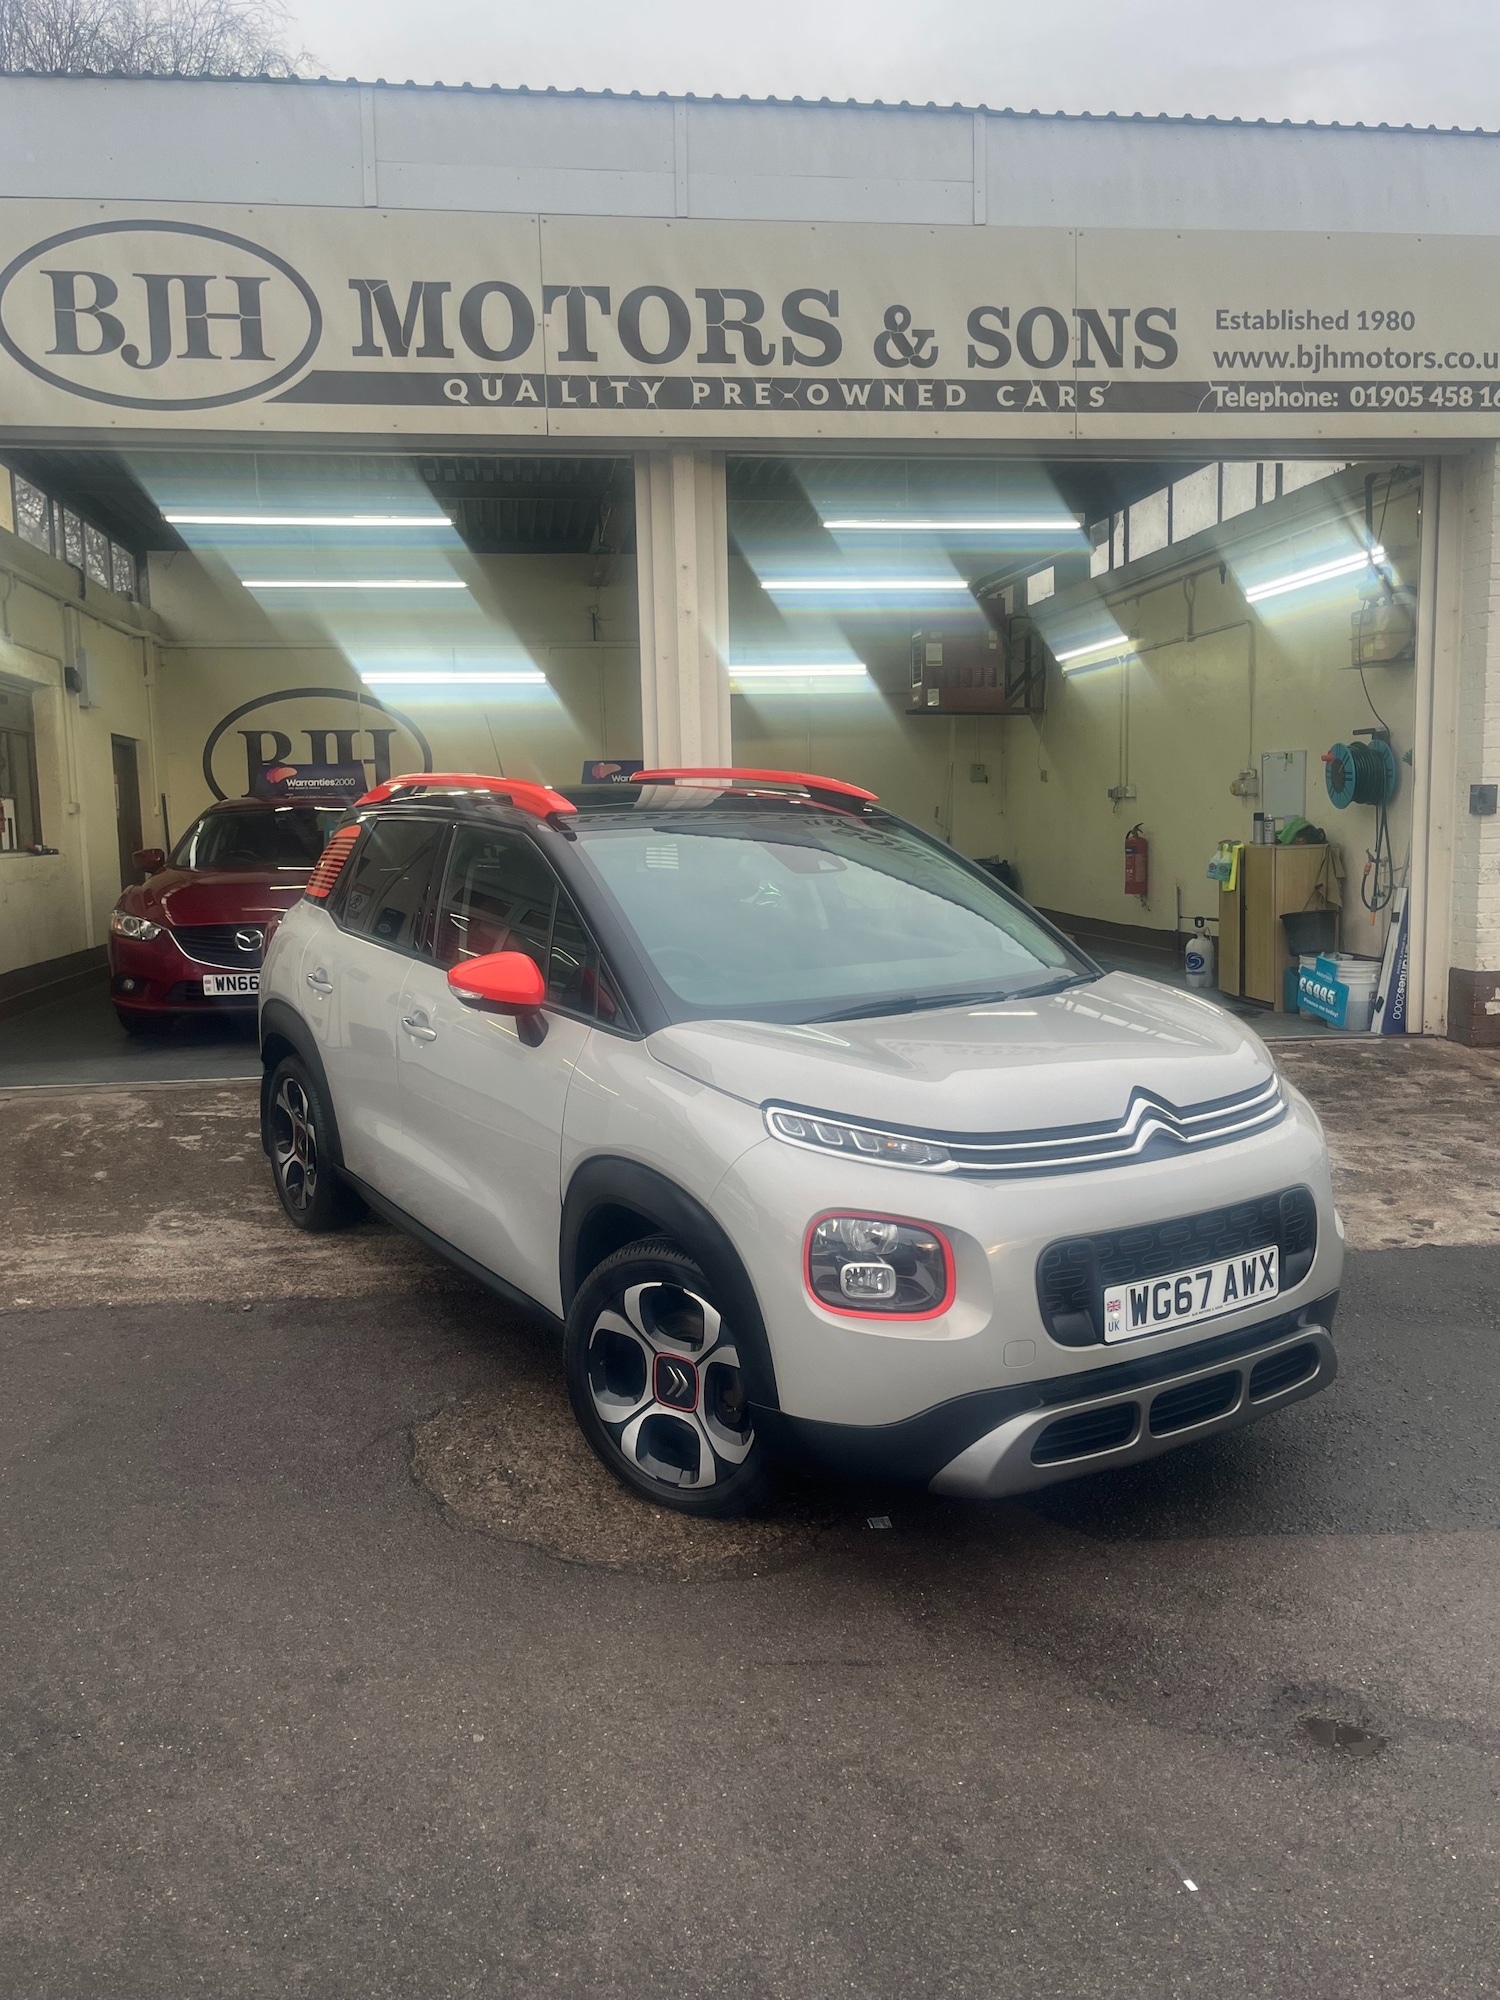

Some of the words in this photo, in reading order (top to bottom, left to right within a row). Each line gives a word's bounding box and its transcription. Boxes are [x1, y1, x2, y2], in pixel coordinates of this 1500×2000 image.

[40, 270, 276, 370] BJH
[348, 278, 843, 367] MOTORS
[873, 304, 939, 369] &
[966, 305, 1179, 370] SONS
[1215, 309, 1350, 332] Established
[1357, 310, 1416, 332] 1980
[443, 378, 663, 406] QUALITY
[692, 382, 967, 406] PRE-OWNED
[996, 385, 1106, 407] CARS
[1211, 385, 1340, 412] Telephone:
[1350, 386, 1424, 408] 01905
[1428, 386, 1474, 407] 458
[285, 778, 356, 788] Warranties2000
[215, 976, 259, 992] WN66
[1299, 977, 1336, 1006] £6995
[1129, 1270, 1213, 1327] WG67
[1222, 1251, 1275, 1304] AWX
[1108, 1320, 1120, 1332] UK
